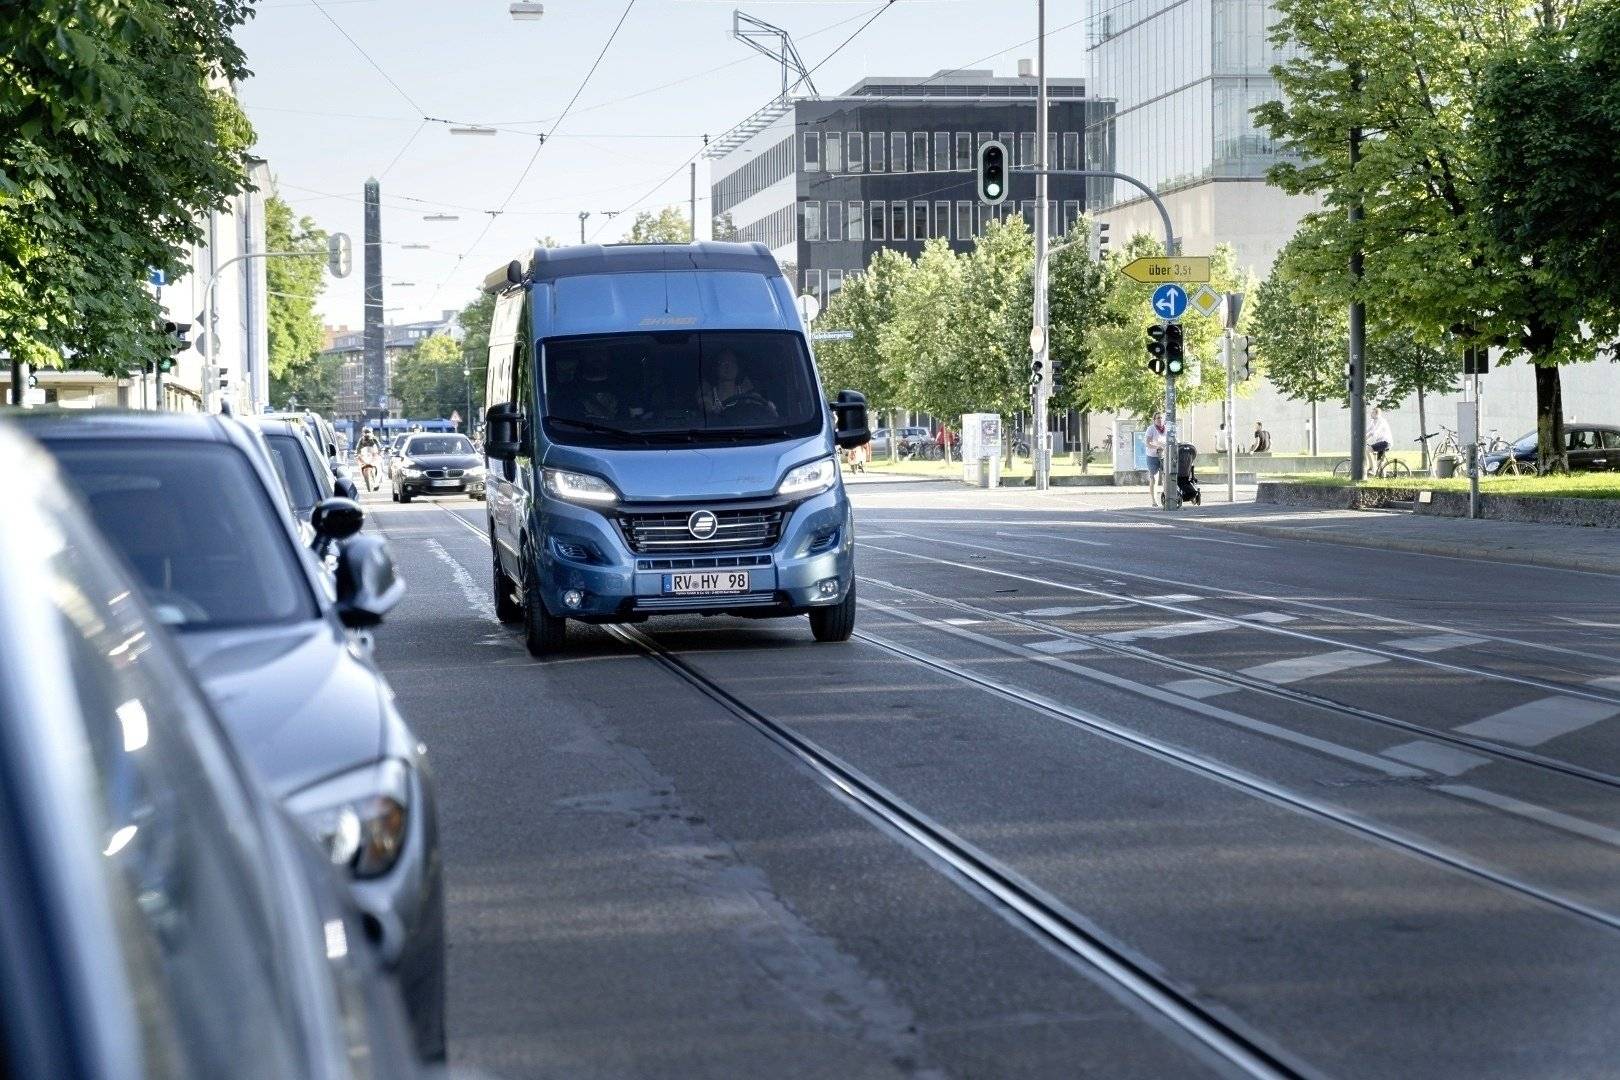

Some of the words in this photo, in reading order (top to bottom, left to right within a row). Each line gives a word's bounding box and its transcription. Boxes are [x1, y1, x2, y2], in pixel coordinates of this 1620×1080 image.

[1149, 264, 1171, 275] über
[674, 575, 692, 589] RV
[701, 574, 718, 588] HY
[729, 574, 745, 588] 98
